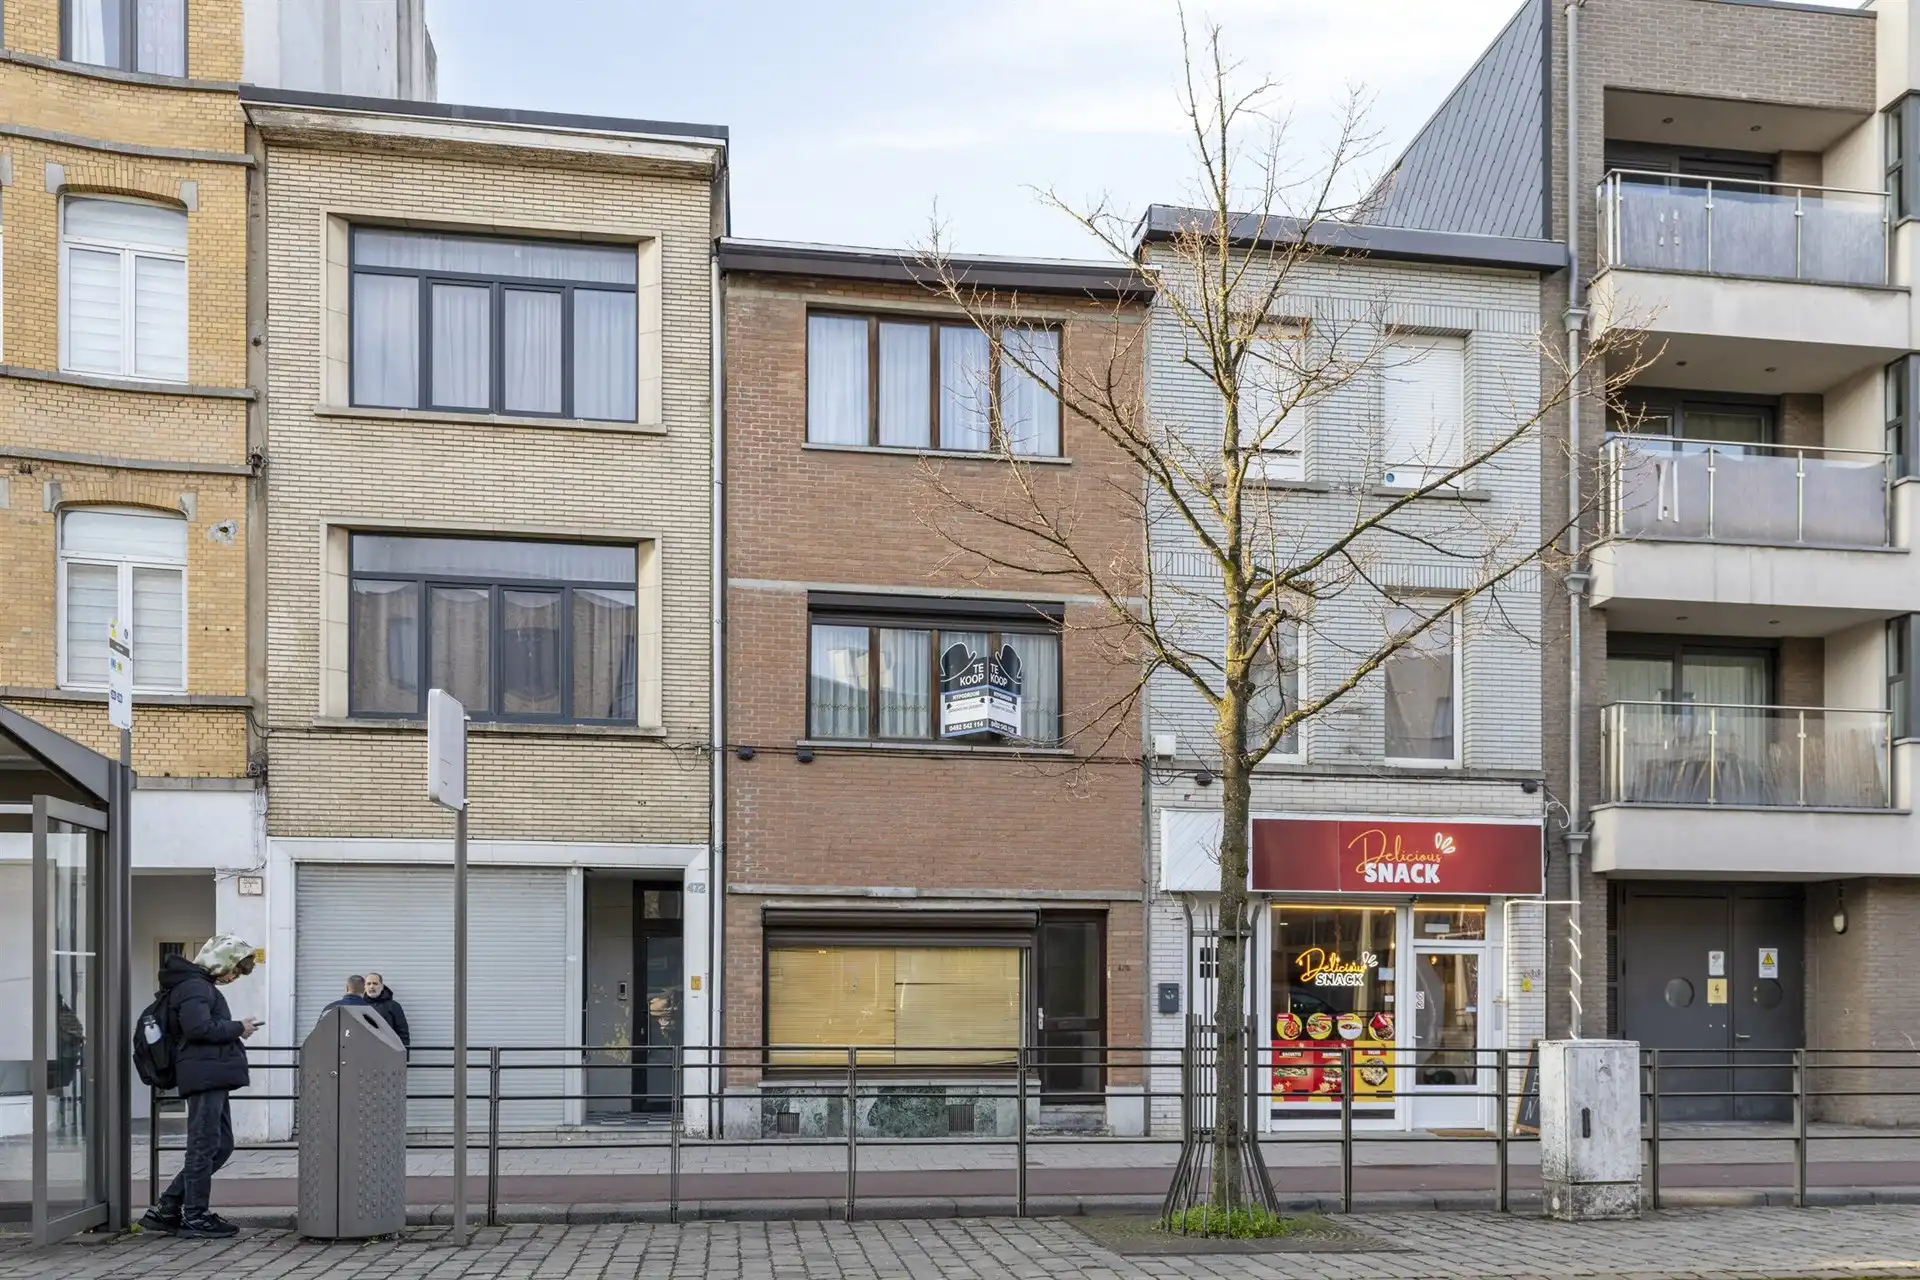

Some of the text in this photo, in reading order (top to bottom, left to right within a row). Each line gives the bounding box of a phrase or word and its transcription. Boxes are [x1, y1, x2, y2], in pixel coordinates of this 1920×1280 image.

[973, 663, 984, 673] TE
[990, 663, 999, 674] TE
[959, 674, 984, 686] KOOP
[990, 674, 1008, 687] KOOP
[1348, 829, 1442, 874] Delicious
[1364, 862, 1441, 884] SNACK
[1295, 947, 1367, 982] Delicious
[1315, 972, 1364, 987] SNACK
